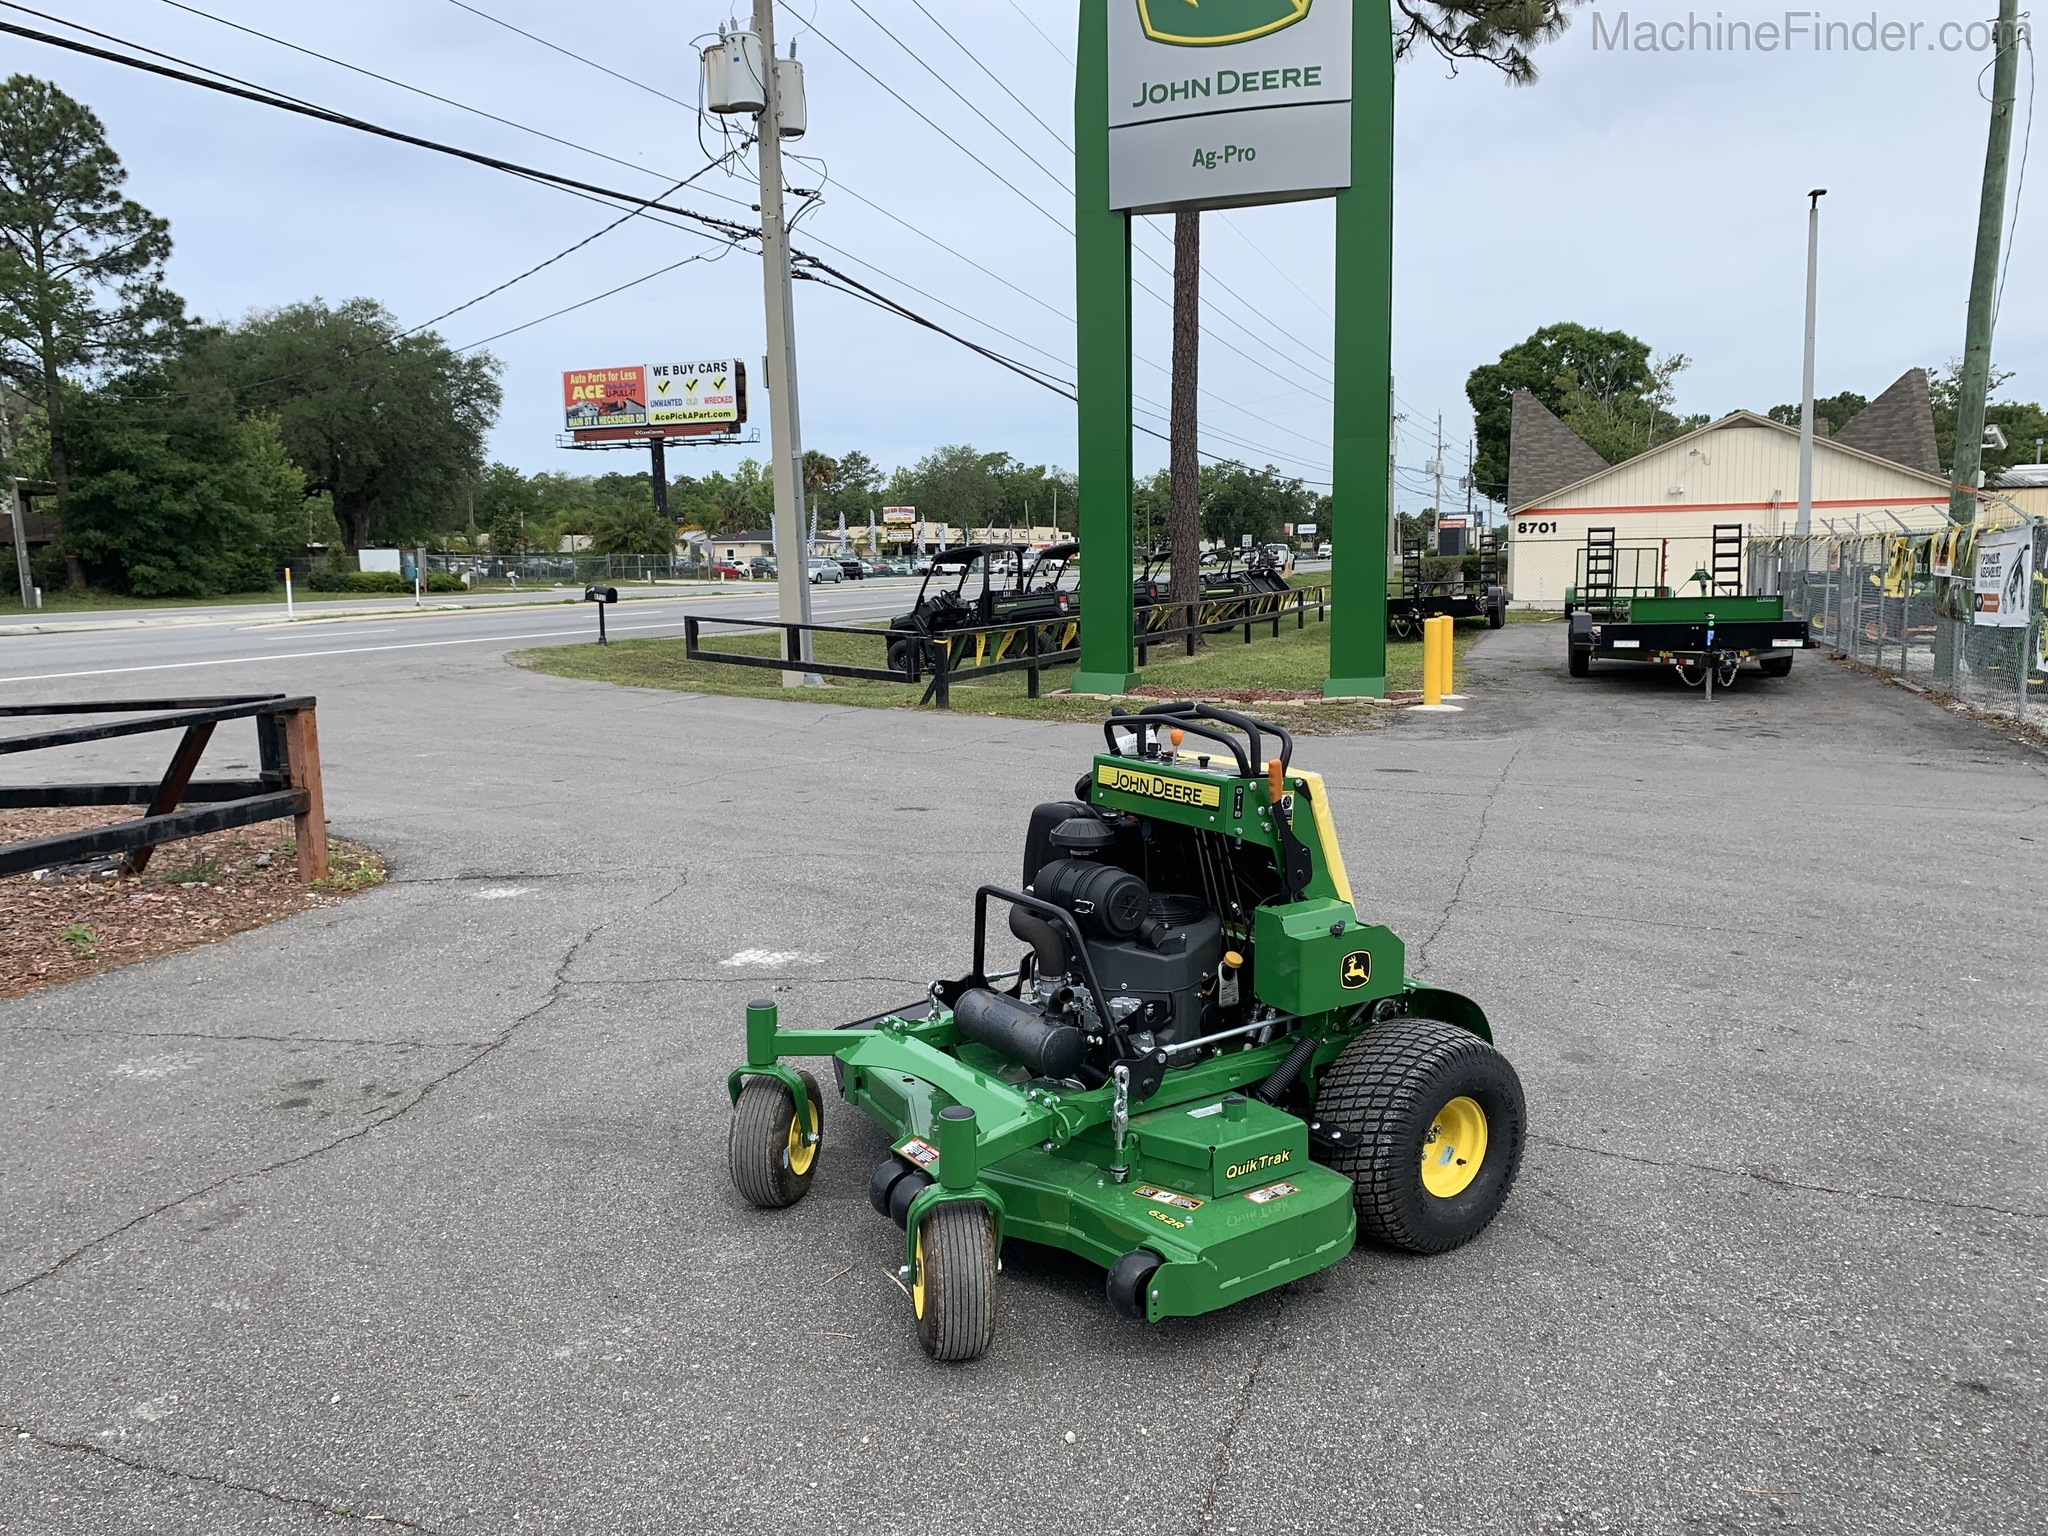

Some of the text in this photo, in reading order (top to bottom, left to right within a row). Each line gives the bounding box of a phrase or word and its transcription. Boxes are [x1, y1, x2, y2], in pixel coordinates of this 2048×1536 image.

[1132, 66, 1322, 107] JOHN DEERE
[1192, 145, 1256, 170] Ag-Pro
[570, 370, 637, 384] Auto Parts for Less
[653, 362, 728, 377] WE BUY CARS
[572, 384, 605, 400] ACE
[650, 396, 733, 408] UNWANTED OLD WRECKED
[569, 417, 583, 427] MAIN
[585, 417, 592, 425] ST
[636, 413, 645, 423] DR
[655, 411, 731, 421] AcePickAPart.com
[1518, 522, 1557, 533] 8701
[1112, 770, 1202, 803] JOHN DEERE
[1147, 1209, 1186, 1230] 652R
